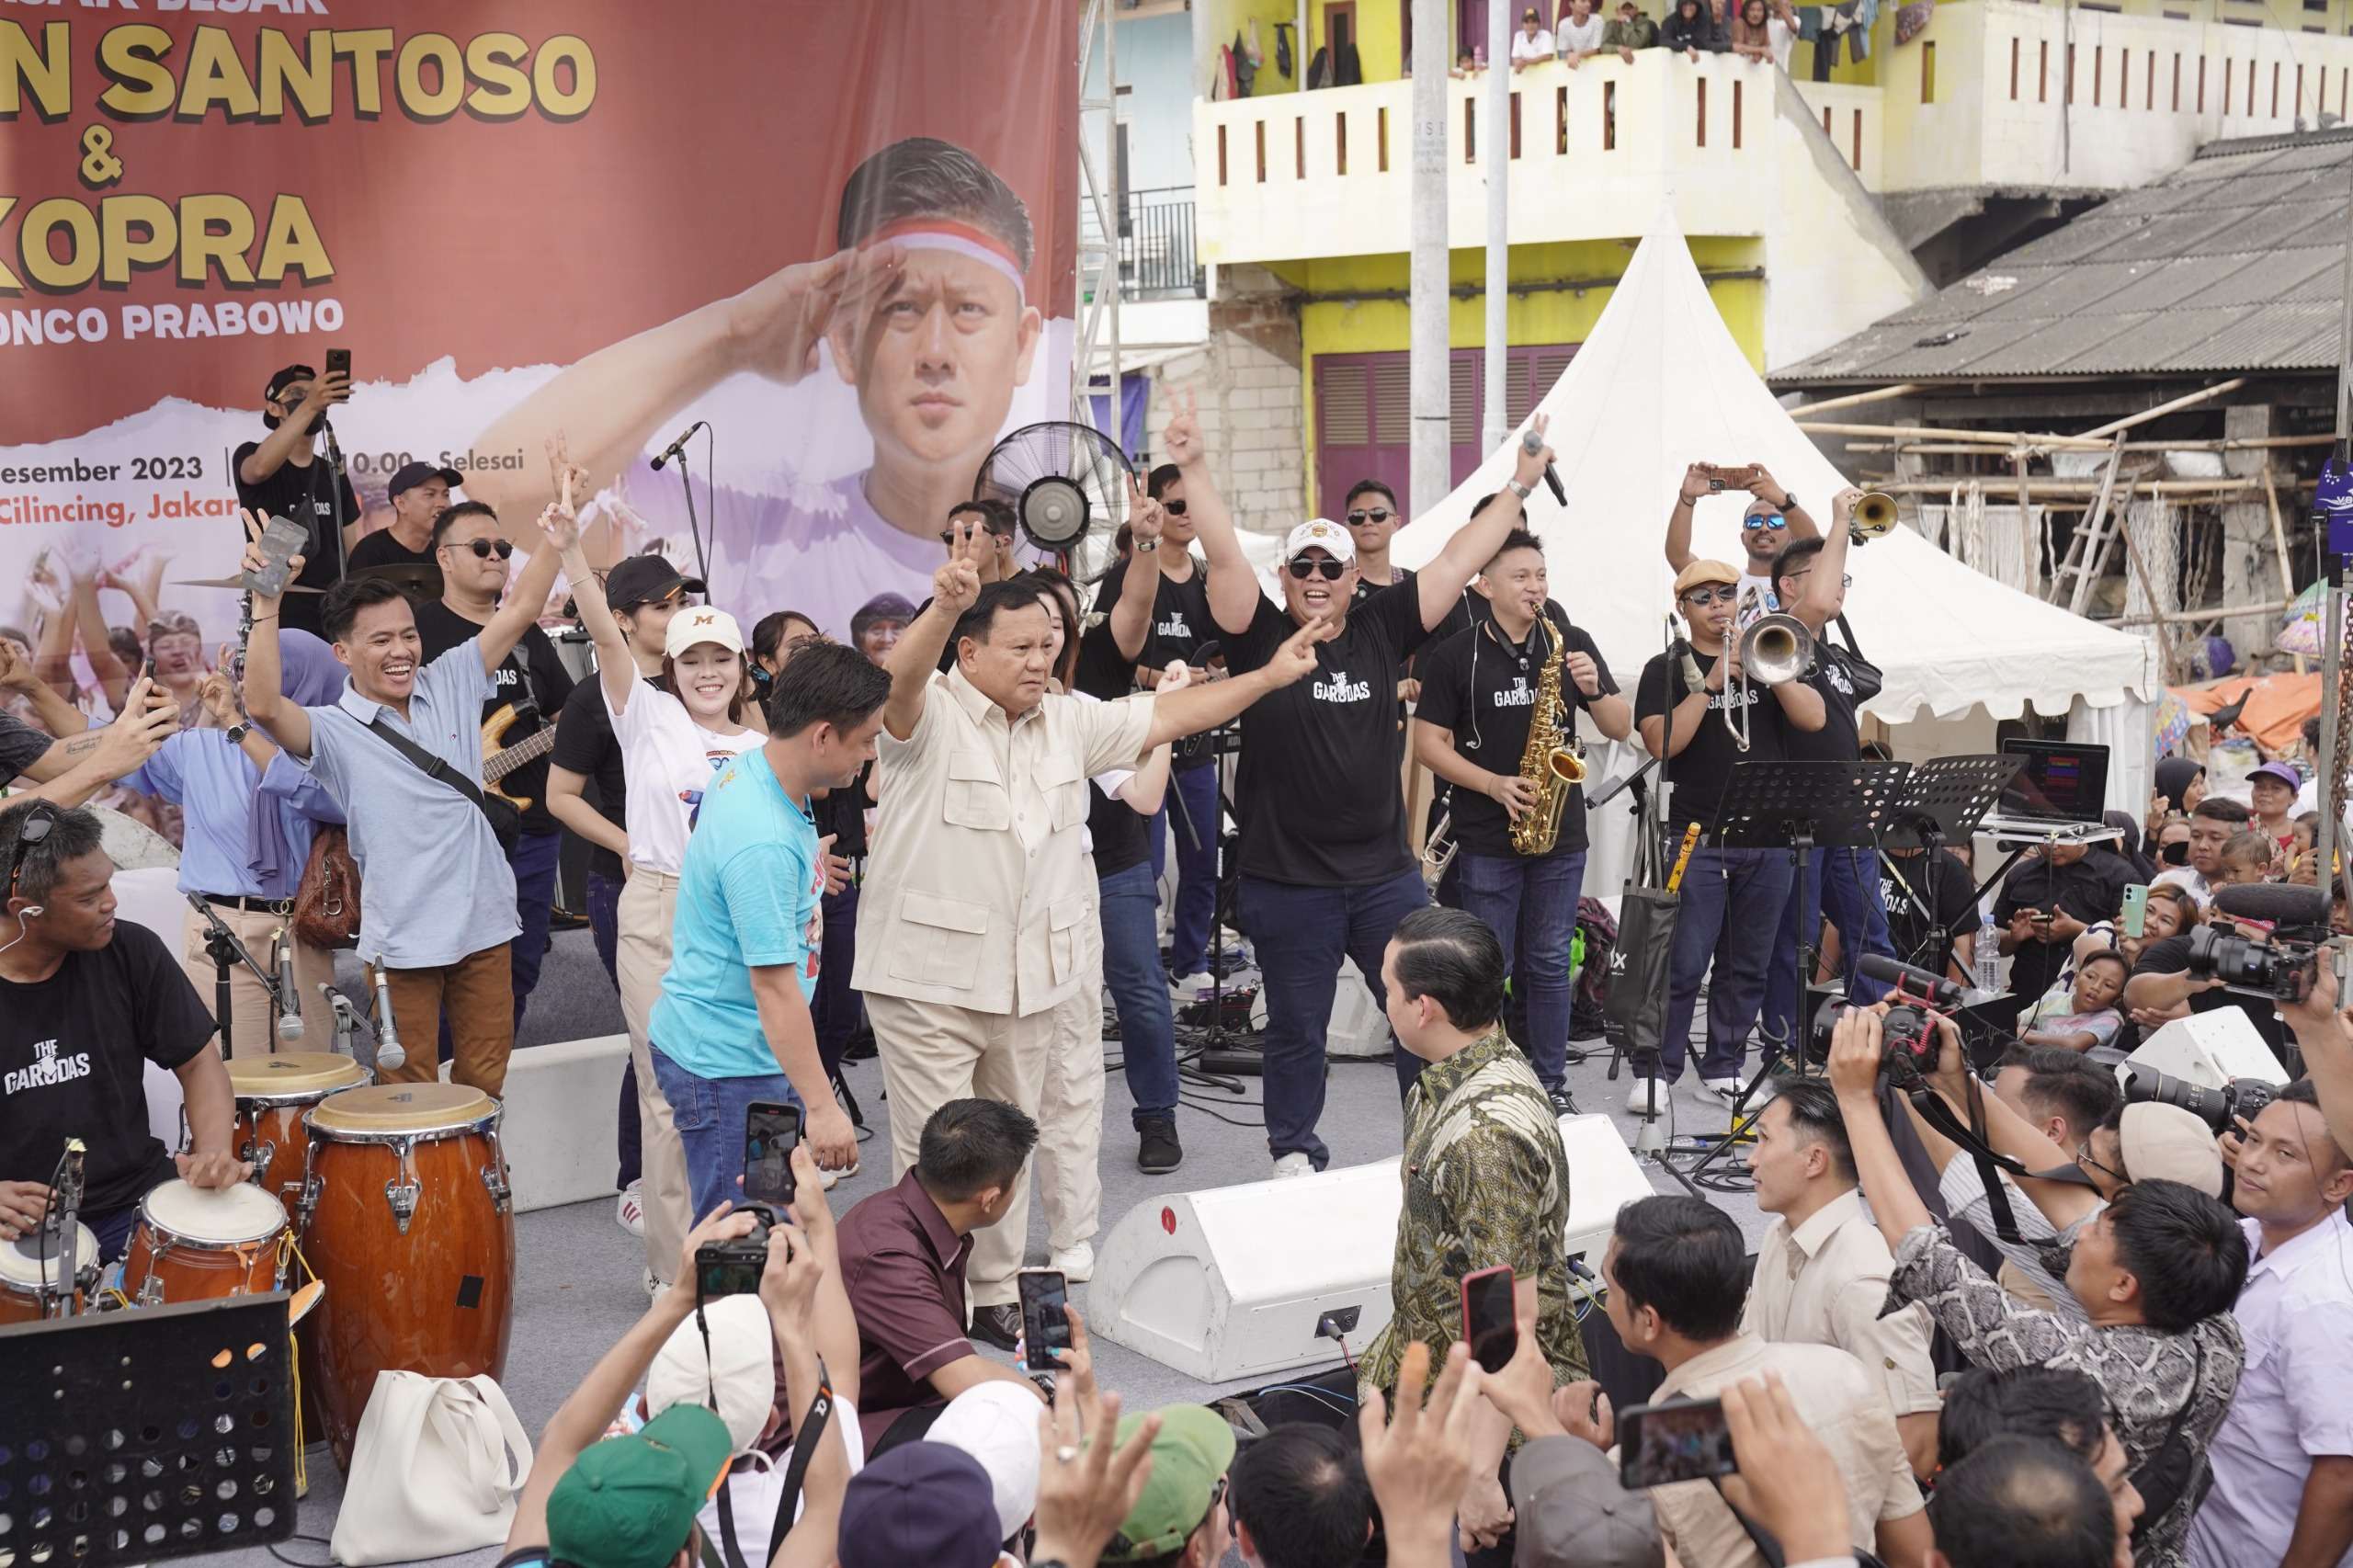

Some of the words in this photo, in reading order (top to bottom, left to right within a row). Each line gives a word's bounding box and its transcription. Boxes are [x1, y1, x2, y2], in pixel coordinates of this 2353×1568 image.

[95, 24, 597, 125] SANTOSO
[79, 123, 124, 190] &
[121, 298, 345, 340] PRABOWO
[1, 458, 120, 484] esember
[131, 456, 203, 481] 2023
[439, 448, 524, 472] Selesai
[693, 615, 715, 626] M
[1329, 671, 1347, 685] THE
[33, 1039, 59, 1059] THE
